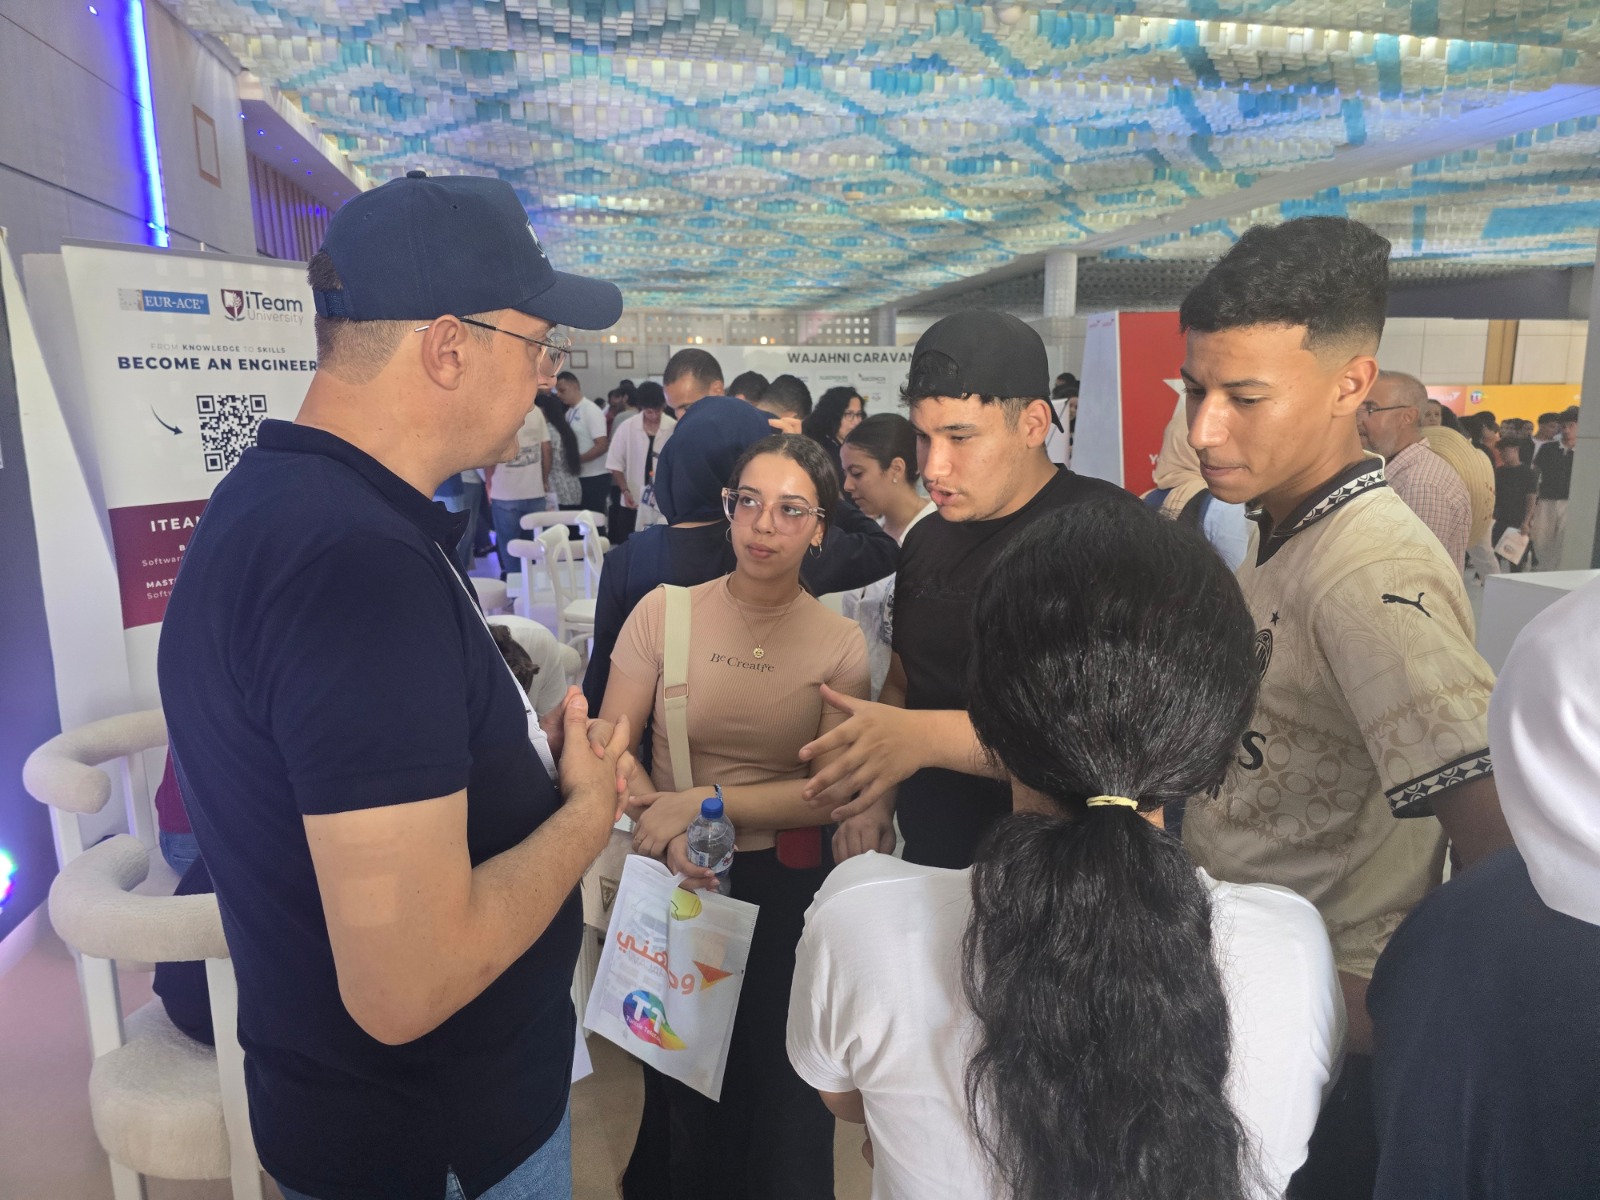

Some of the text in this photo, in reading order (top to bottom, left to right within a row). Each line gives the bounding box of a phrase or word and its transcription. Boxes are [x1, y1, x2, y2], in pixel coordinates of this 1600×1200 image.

[245, 290, 303, 313] iTeam
[247, 309, 304, 326] University
[150, 343, 179, 351] FROM
[182, 344, 240, 352] KNOWLEDGE
[257, 346, 286, 354] SKILLS
[117, 355, 317, 372] BECOME AN ENGINEER
[787, 352, 850, 364] WAJAHNI
[146, 578, 177, 589] MAST
